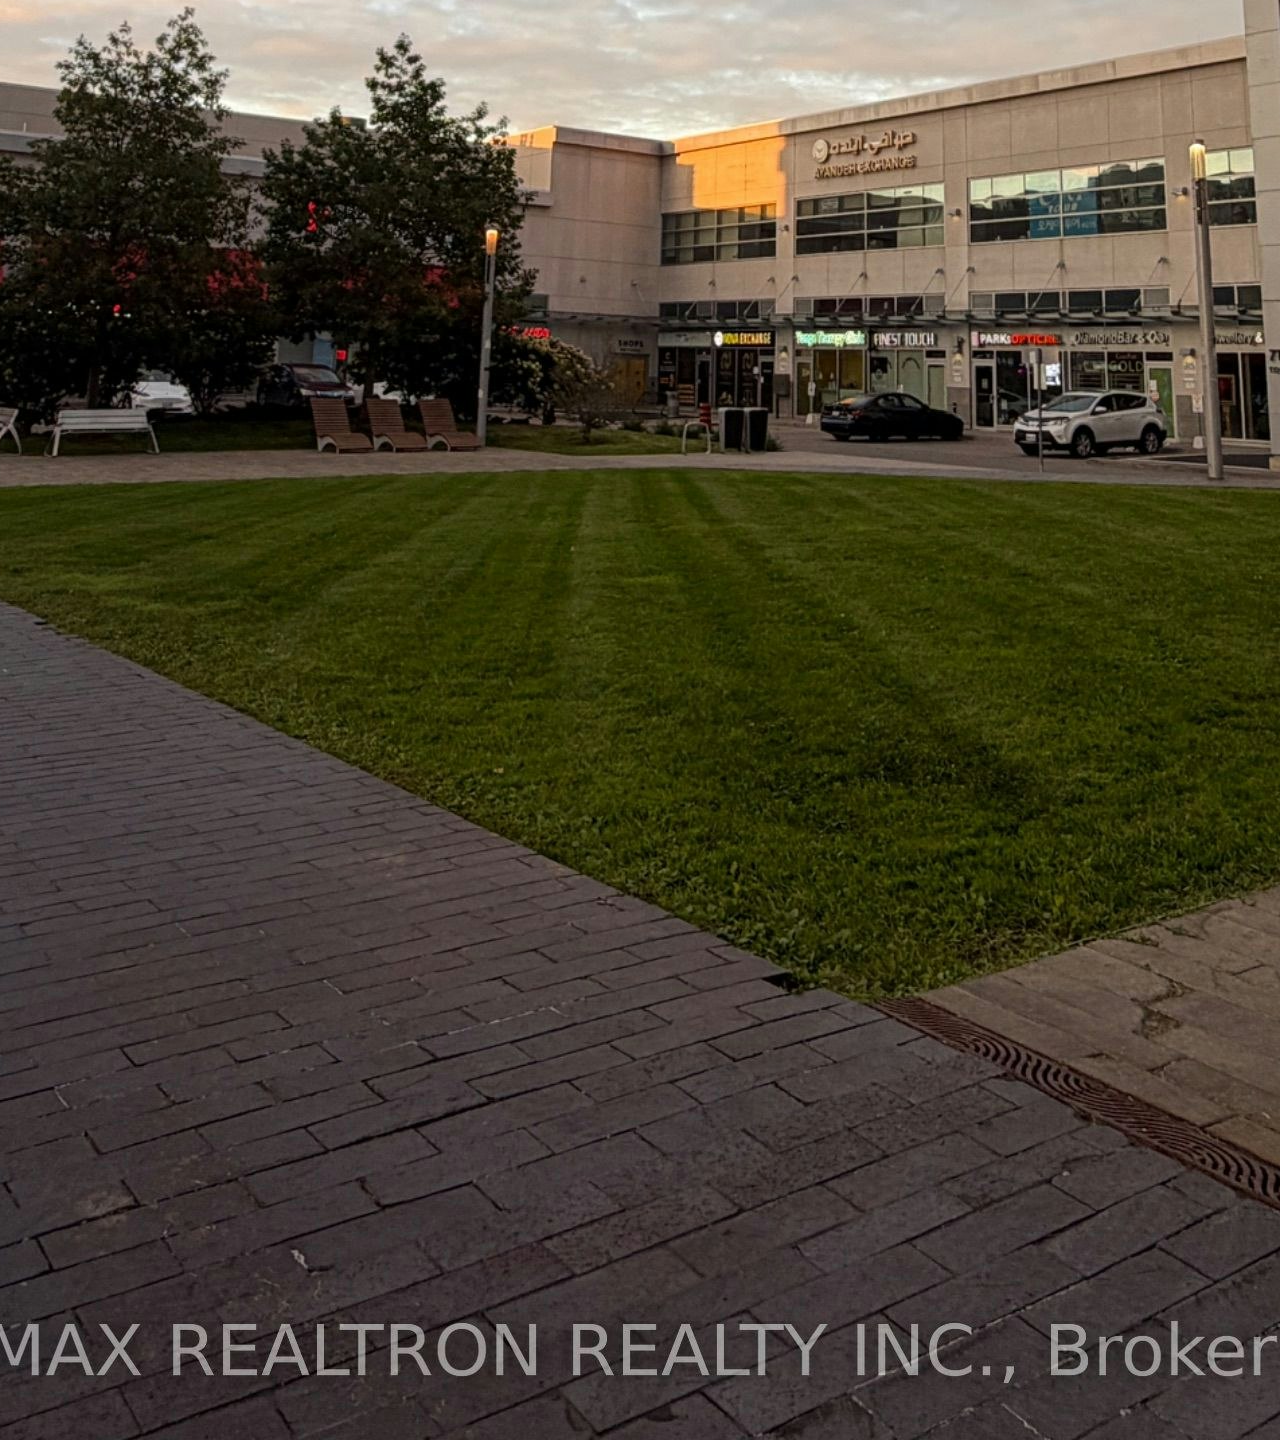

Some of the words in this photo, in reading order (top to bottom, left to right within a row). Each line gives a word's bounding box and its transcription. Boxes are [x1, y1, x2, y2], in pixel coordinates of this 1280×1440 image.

[814, 162, 856, 179] AYANDEH
[857, 155, 917, 175] EXCHANGE
[874, 332, 902, 346] FINEST
[904, 332, 936, 347] TOUCH
[1255, 331, 1263, 344] &
